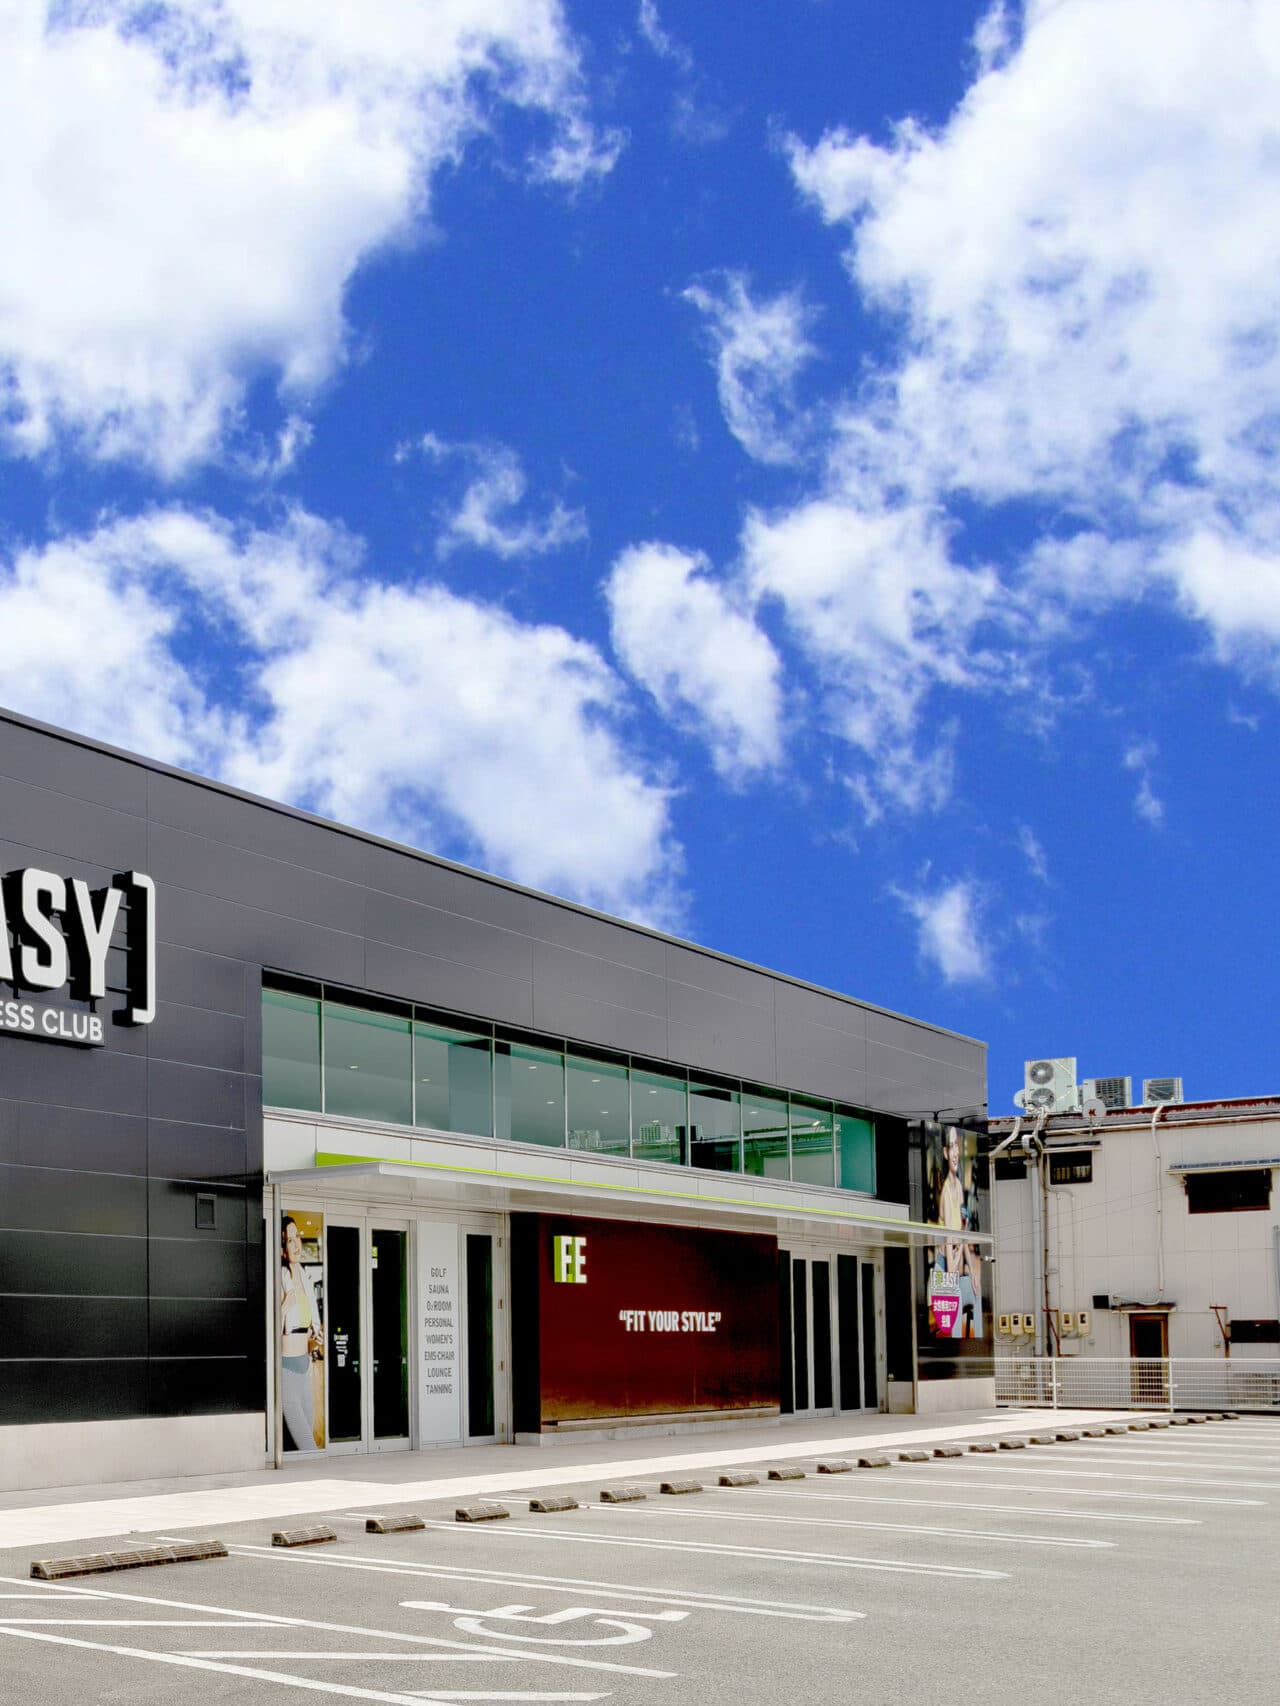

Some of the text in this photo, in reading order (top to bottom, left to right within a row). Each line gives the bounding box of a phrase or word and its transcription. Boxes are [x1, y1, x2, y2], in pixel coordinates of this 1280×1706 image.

[42, 1009, 103, 1041] CLUB
[430, 1267, 447, 1278] GOLF
[428, 1284, 449, 1294] SAUNA
[424, 1318, 454, 1327] PERSONAL
[648, 1310, 680, 1332] YOUR
[425, 1334, 453, 1344] WOMEN'S
[427, 1367, 452, 1378] LOUNGE
[425, 1384, 453, 1395] TANNING
